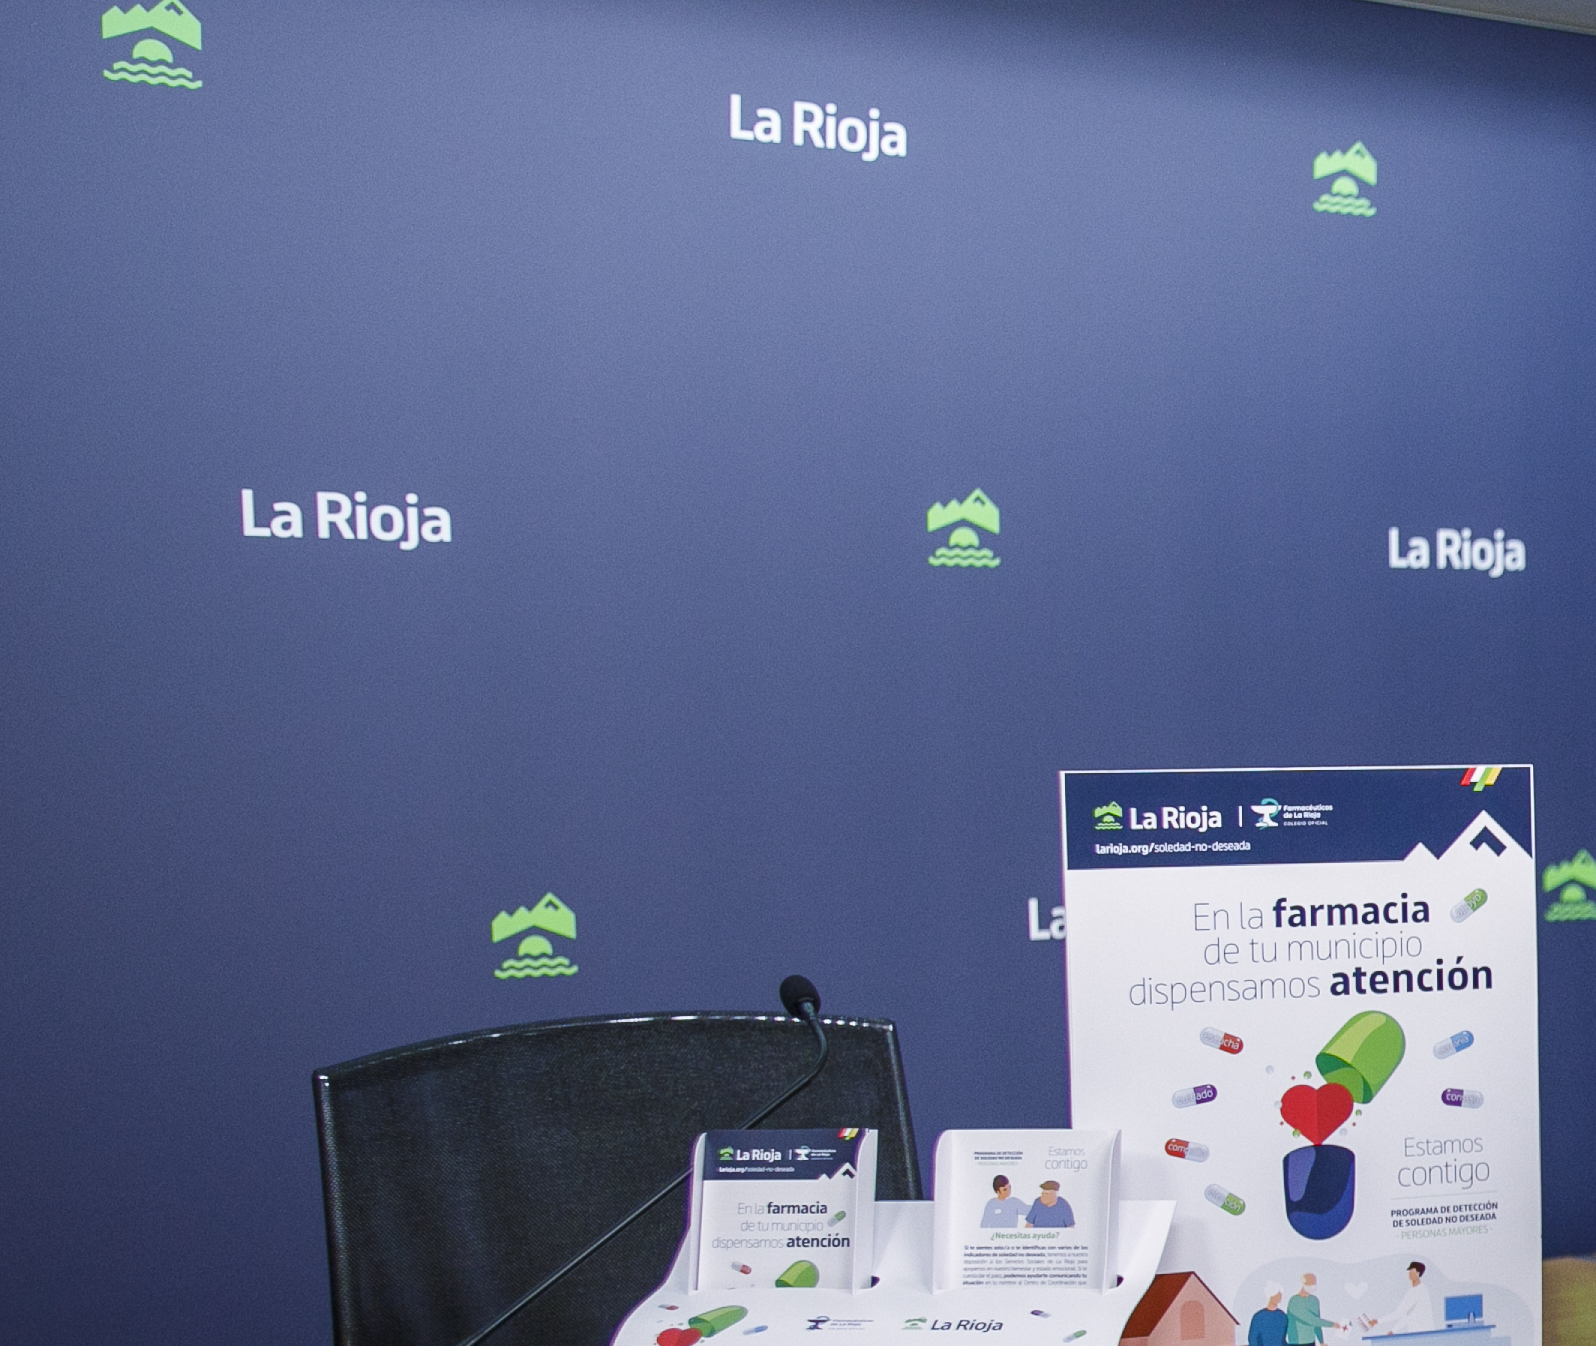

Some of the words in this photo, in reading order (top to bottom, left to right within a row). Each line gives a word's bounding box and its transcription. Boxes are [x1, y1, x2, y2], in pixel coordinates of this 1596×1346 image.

[730, 94, 781, 143] La
[793, 101, 907, 161] Rioja
[242, 489, 303, 538] La
[317, 491, 451, 550] Rioja
[1389, 527, 1429, 569] La
[1437, 528, 1525, 577] Rioja
[1130, 807, 1157, 830] La
[1162, 805, 1222, 832] Rioja
[1303, 811, 1322, 820] Rioja
[1095, 841, 1251, 856] larioja.org/soledad-no-deseada
[1028, 896, 1066, 941] La
[1193, 902, 1229, 932] En
[1239, 901, 1264, 930] la
[1272, 892, 1430, 928] farmacia
[1204, 937, 1239, 965] de
[1248, 939, 1277, 964] tu
[1287, 931, 1422, 965] municipio
[1129, 974, 1321, 1011] dispensamos
[1329, 956, 1493, 996] atención
[1048, 1146, 1085, 1156] Estamos
[1404, 1137, 1484, 1157] Estamos
[737, 1150, 749, 1161] La
[751, 1149, 782, 1163] Rioja
[1045, 1158, 1088, 1173] contigo
[1398, 1158, 1490, 1190] contigo
[737, 1202, 753, 1215] En
[754, 1202, 765, 1215] la
[767, 1201, 828, 1215] farmacia
[1390, 1206, 1439, 1218] PROGRAMA
[1440, 1206, 1450, 1214] DE
[1453, 1200, 1498, 1213] DETECCIÓN
[740, 1220, 755, 1232] de
[758, 1222, 769, 1232] tu
[772, 1219, 824, 1234] municipio
[1393, 1220, 1404, 1228] DE
[1405, 1216, 1444, 1227] SOLEDAD
[1445, 1215, 1458, 1224] NO
[1459, 1212, 1497, 1223] DESEADA
[990, 1232, 1031, 1241] ¿Necesitas
[1032, 1231, 1060, 1241] ayuda?
[1401, 1228, 1447, 1240] PERSONAS
[1449, 1225, 1489, 1237] MAYORES
[712, 1236, 785, 1250] dispensamos
[786, 1233, 850, 1248] atención
[930, 1319, 952, 1331] La
[955, 1318, 1004, 1333] Rioja
